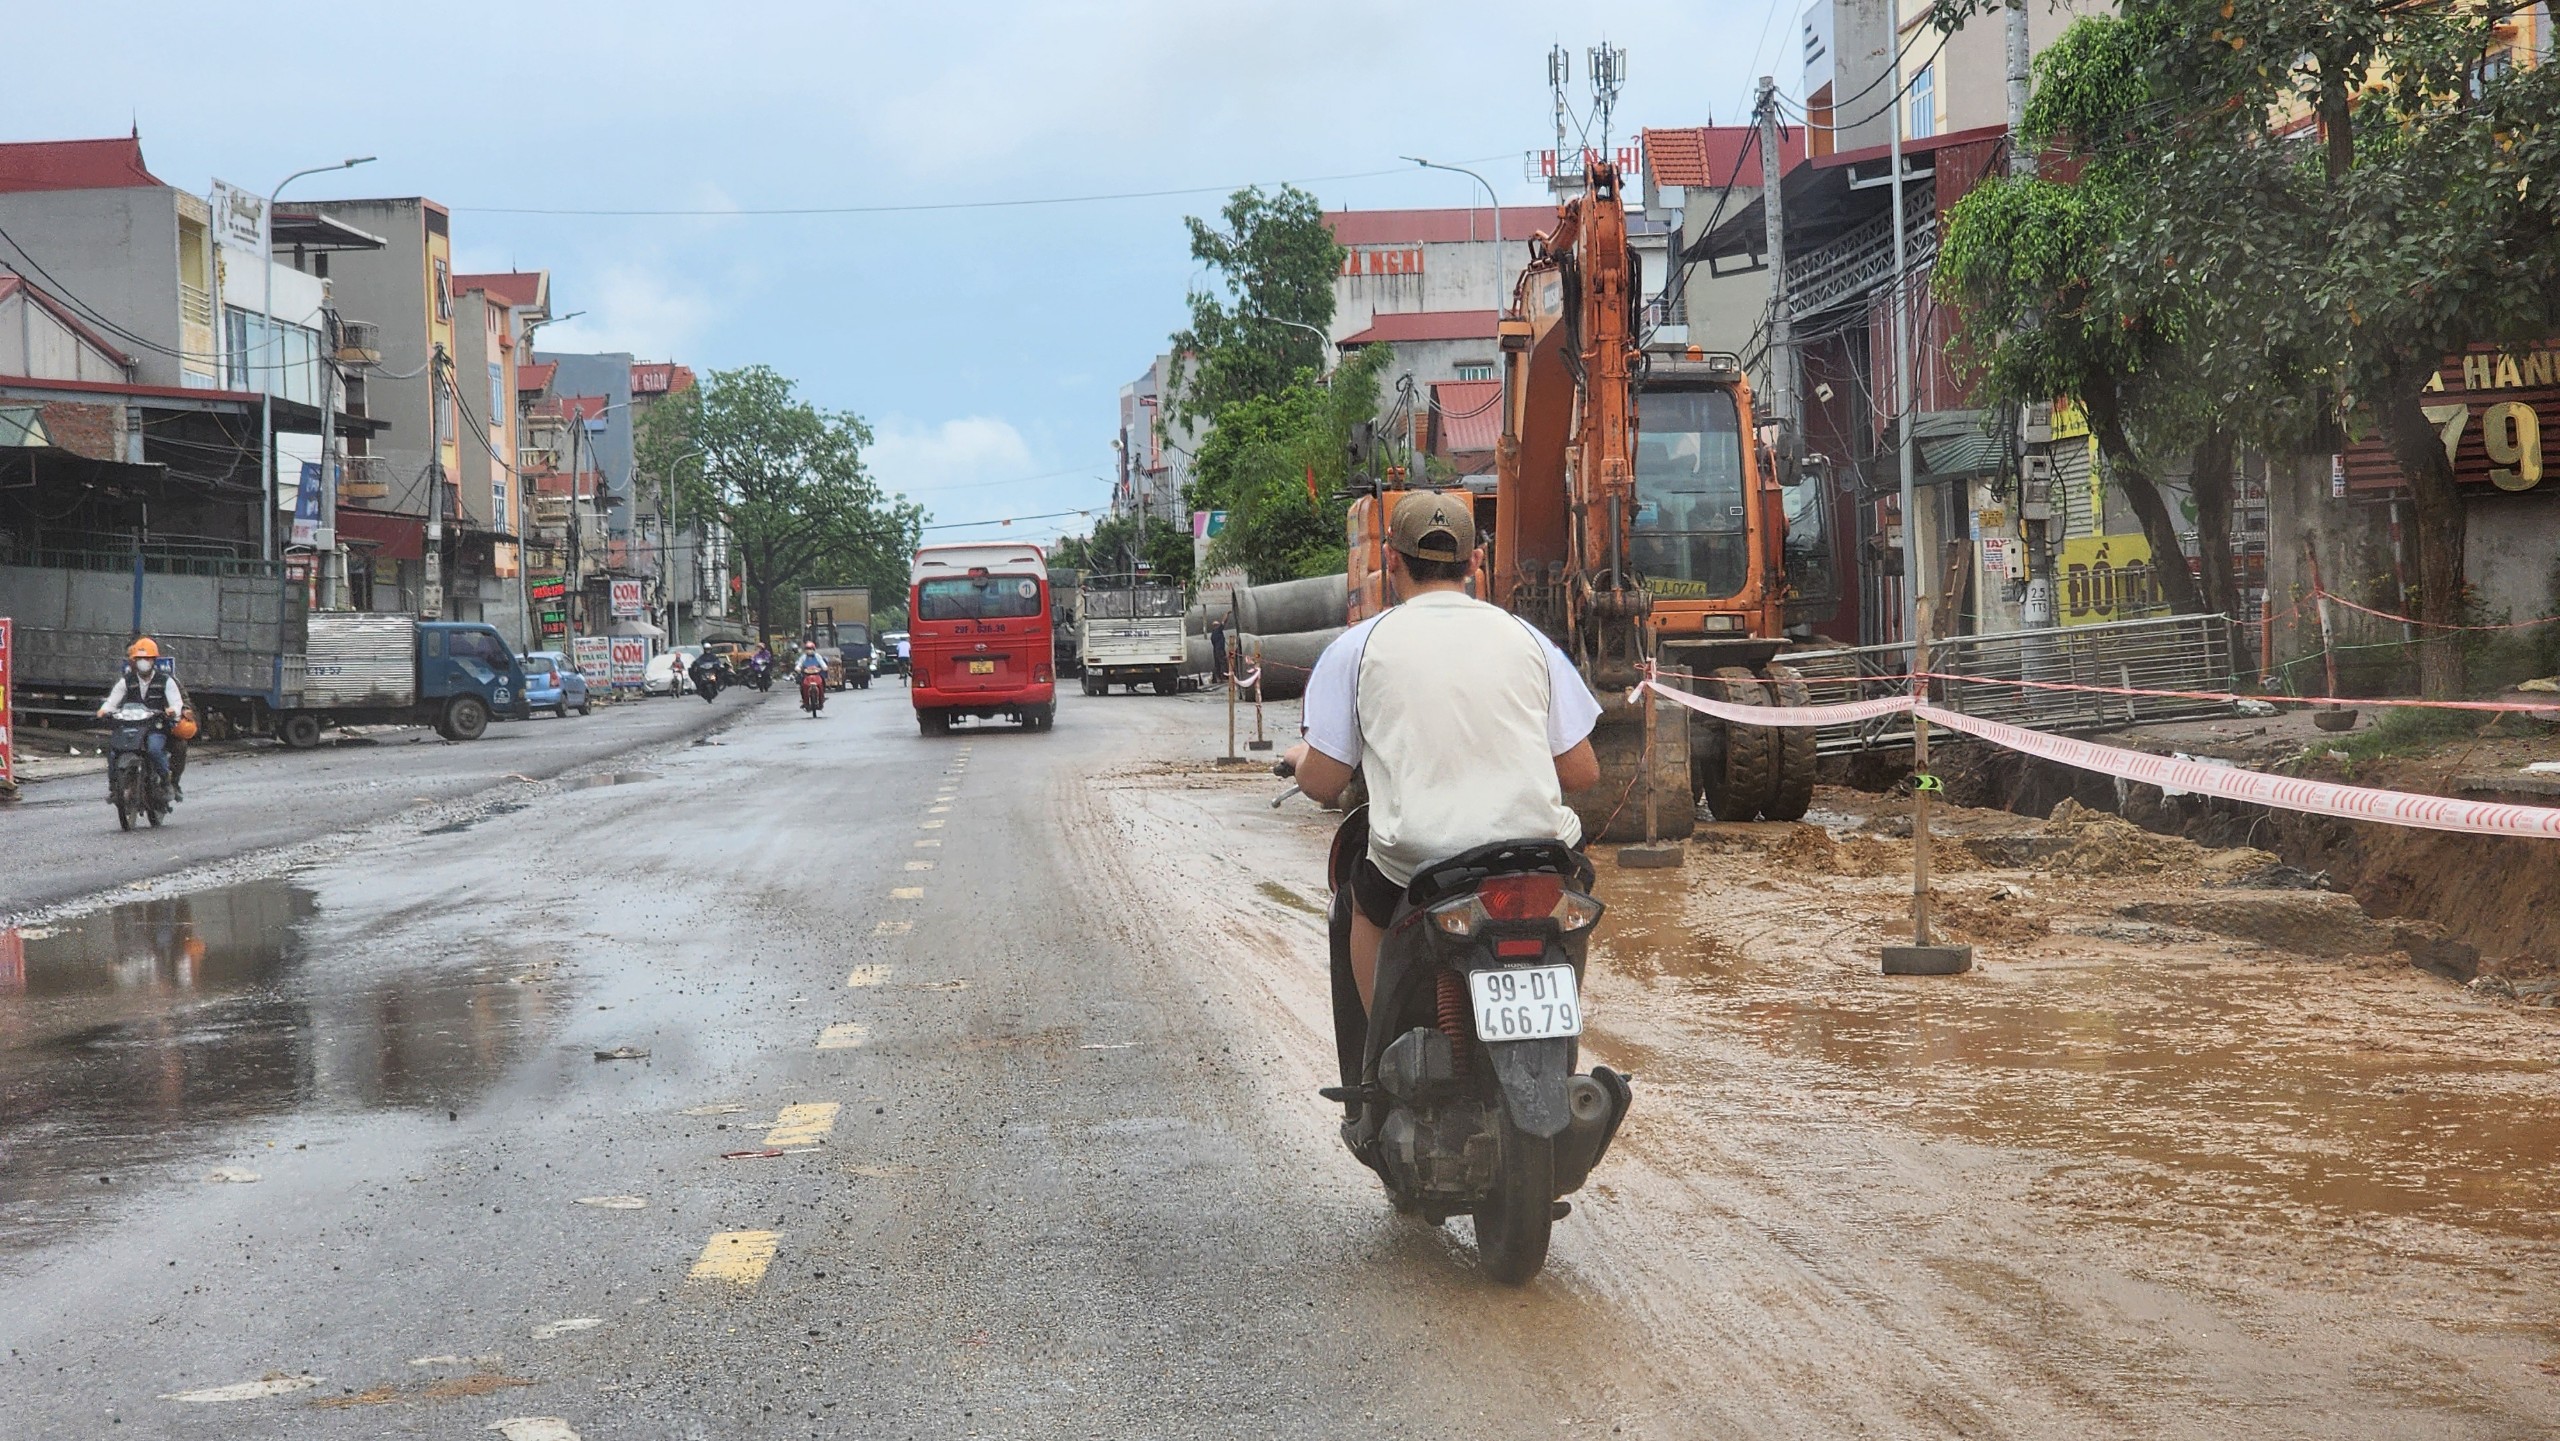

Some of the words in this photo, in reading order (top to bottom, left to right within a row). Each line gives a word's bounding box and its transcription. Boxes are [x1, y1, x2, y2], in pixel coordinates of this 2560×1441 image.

[1339, 247, 1362, 275] À
[1369, 239, 1424, 275] NGHỈ
[2422, 370, 2445, 393] A
[2462, 344, 2560, 390] HÀN
[2420, 401, 2544, 491] 79
[1985, 539, 2011, 549] TAX
[613, 583, 639, 600] CƠM
[1645, 580, 1705, 595] 9LA-0744
[613, 643, 644, 663] CƠM
[1487, 971, 1559, 1003] 99-D1
[1484, 1003, 1574, 1037] 466.79
